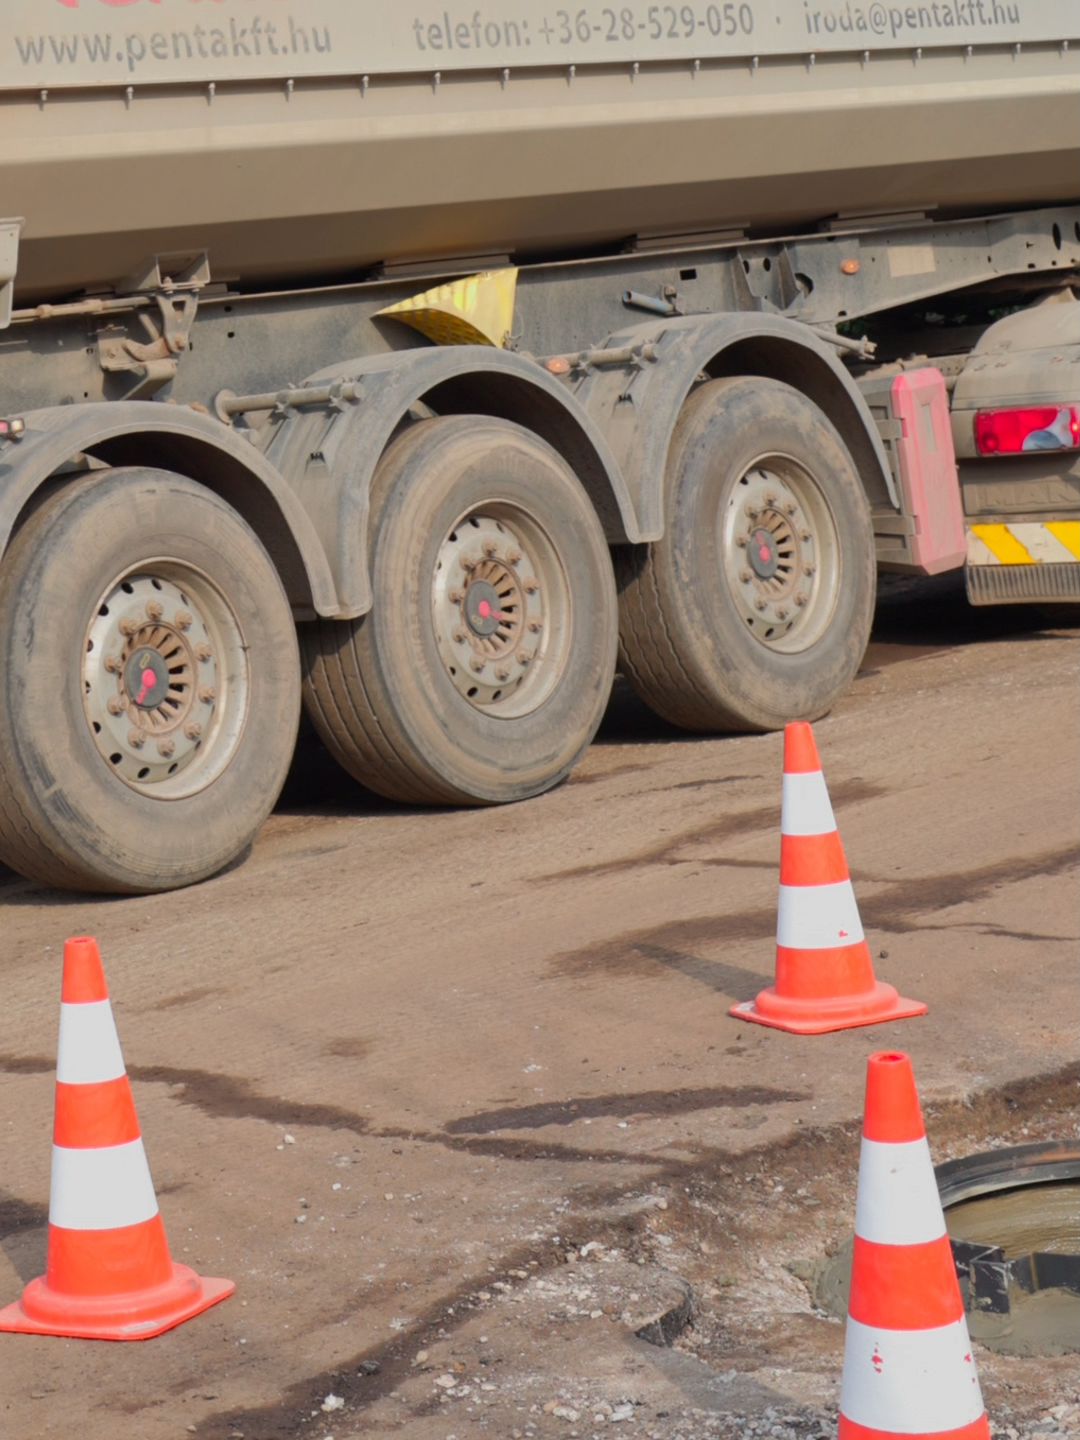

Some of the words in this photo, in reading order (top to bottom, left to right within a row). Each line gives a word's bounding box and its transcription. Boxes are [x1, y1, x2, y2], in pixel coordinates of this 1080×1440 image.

[14, 15, 333, 71] www.pentakft.hu
[412, 10, 531, 51] telefon:
[538, 3, 754, 46] +36-28-529-050
